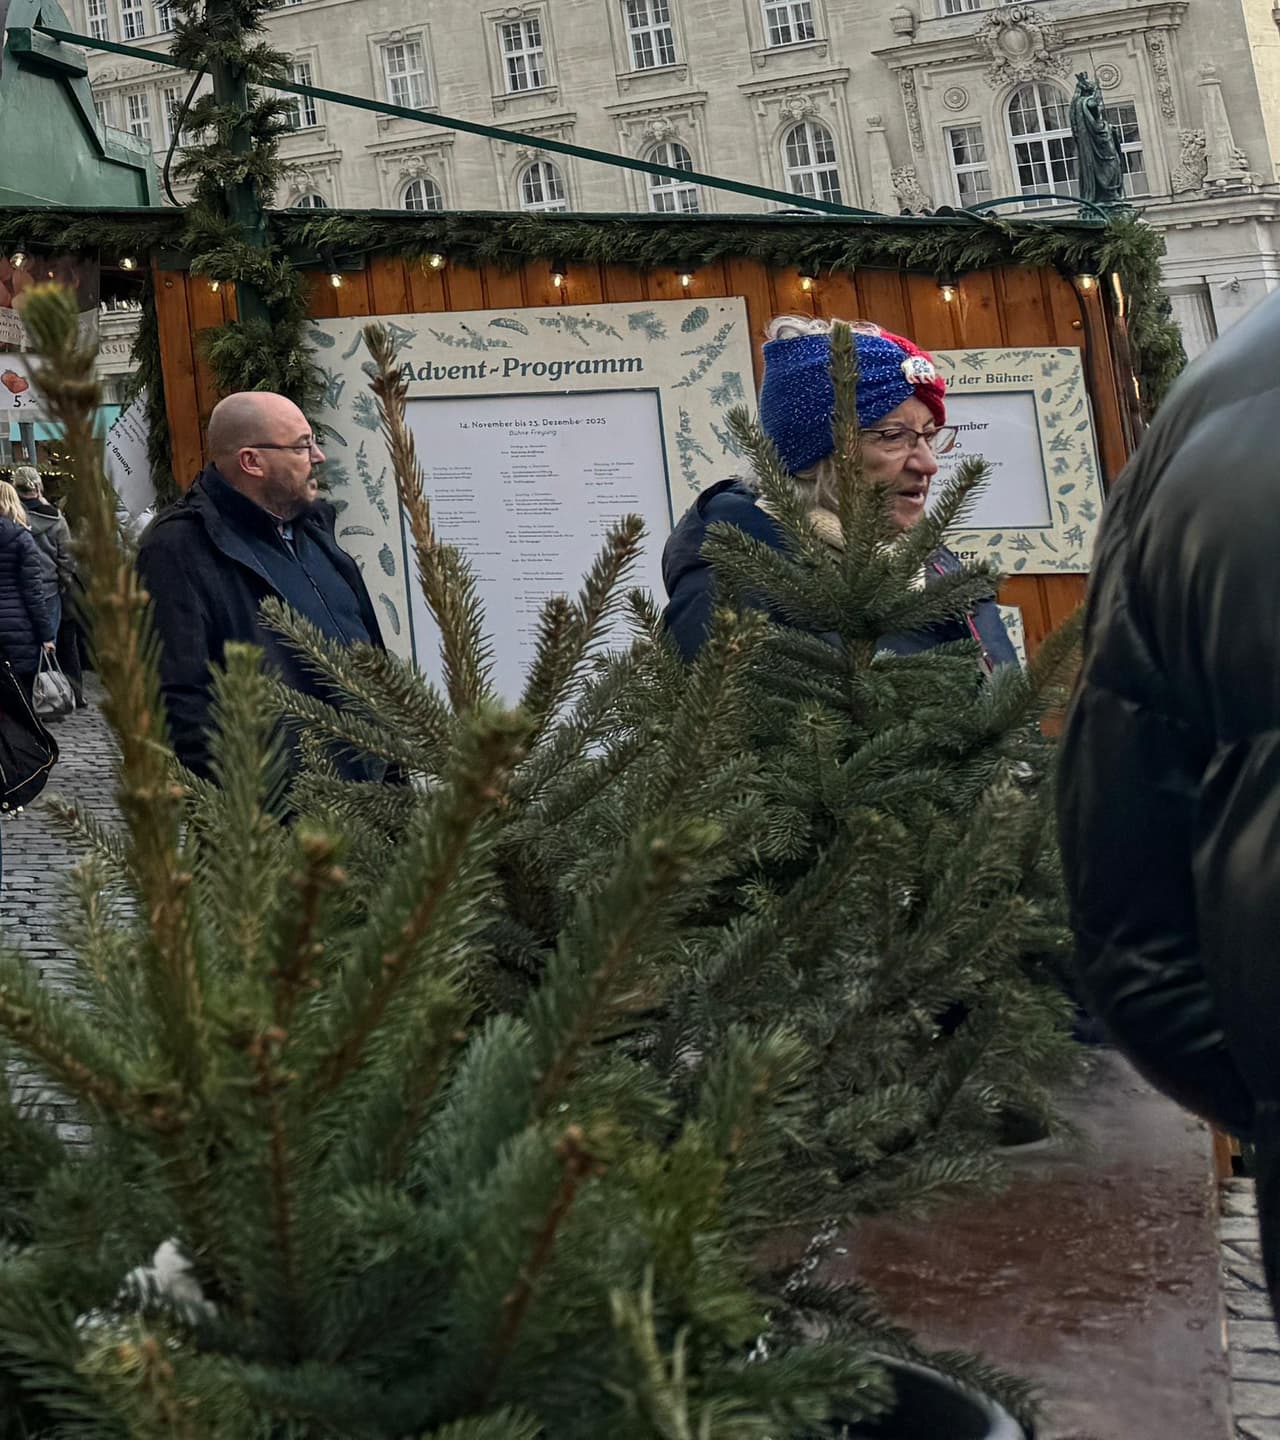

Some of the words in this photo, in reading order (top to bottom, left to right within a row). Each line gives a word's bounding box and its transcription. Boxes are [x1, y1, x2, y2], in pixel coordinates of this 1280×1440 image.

[959, 375, 982, 385] der
[986, 373, 1034, 384] Bühne:
[472, 420, 513, 429] November
[515, 419, 526, 427] bis
